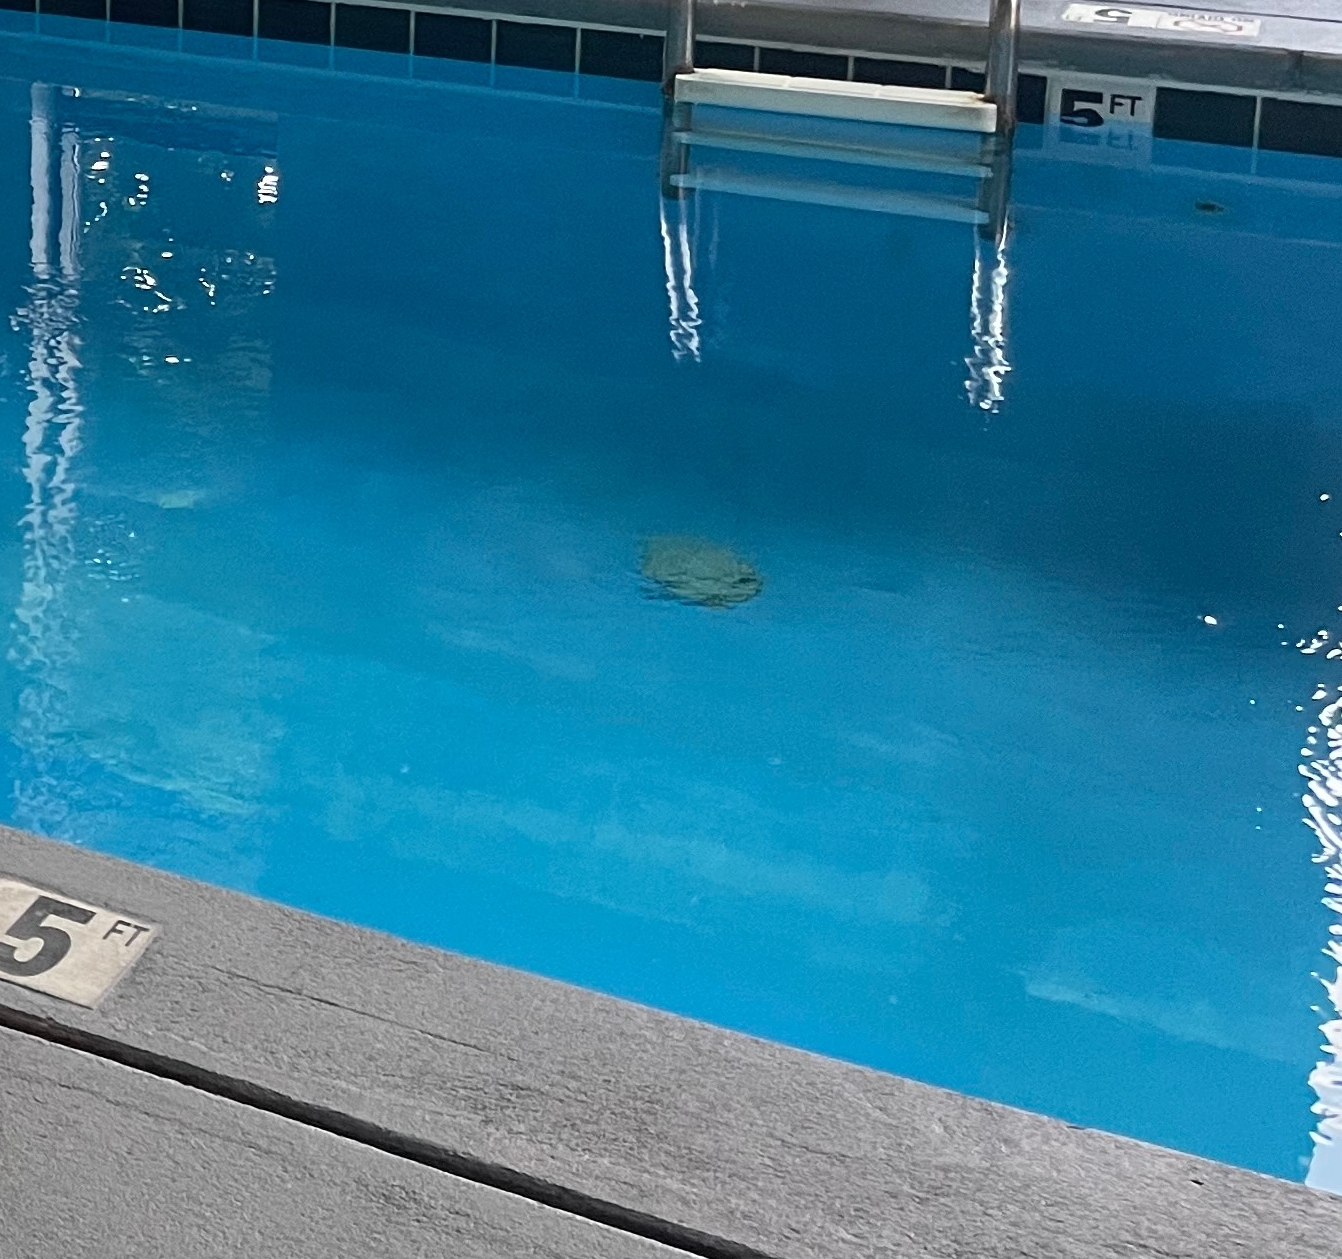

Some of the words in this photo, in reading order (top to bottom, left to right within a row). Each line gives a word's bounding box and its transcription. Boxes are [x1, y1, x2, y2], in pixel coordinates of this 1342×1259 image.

[1060, 88, 1104, 127] 5
[1110, 94, 1143, 117] FT
[102, 920, 150, 948] FT
